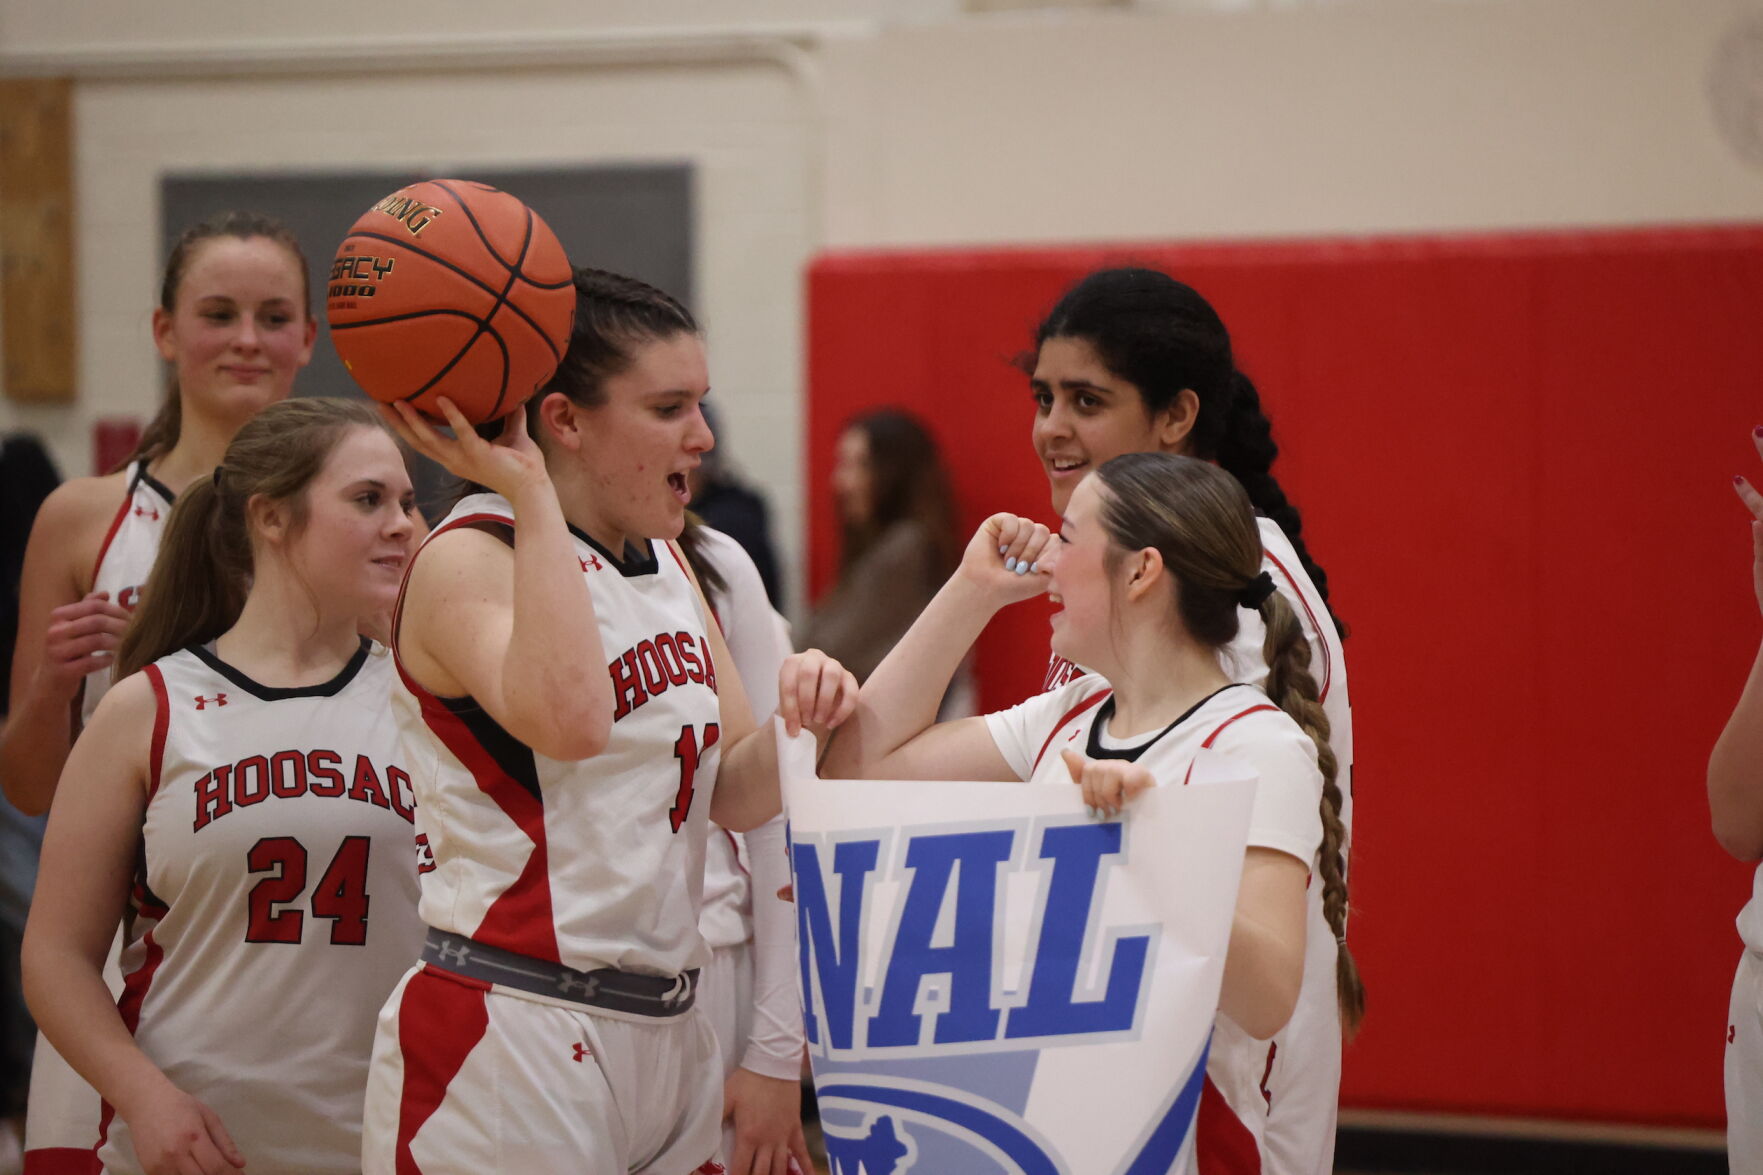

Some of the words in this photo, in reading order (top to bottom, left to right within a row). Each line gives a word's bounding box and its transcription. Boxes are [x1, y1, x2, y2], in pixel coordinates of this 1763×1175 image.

[370, 196, 443, 235] DING
[193, 749, 417, 833] HOOSAC
[245, 835, 371, 946] 24
[787, 820, 1150, 1050] NAL
